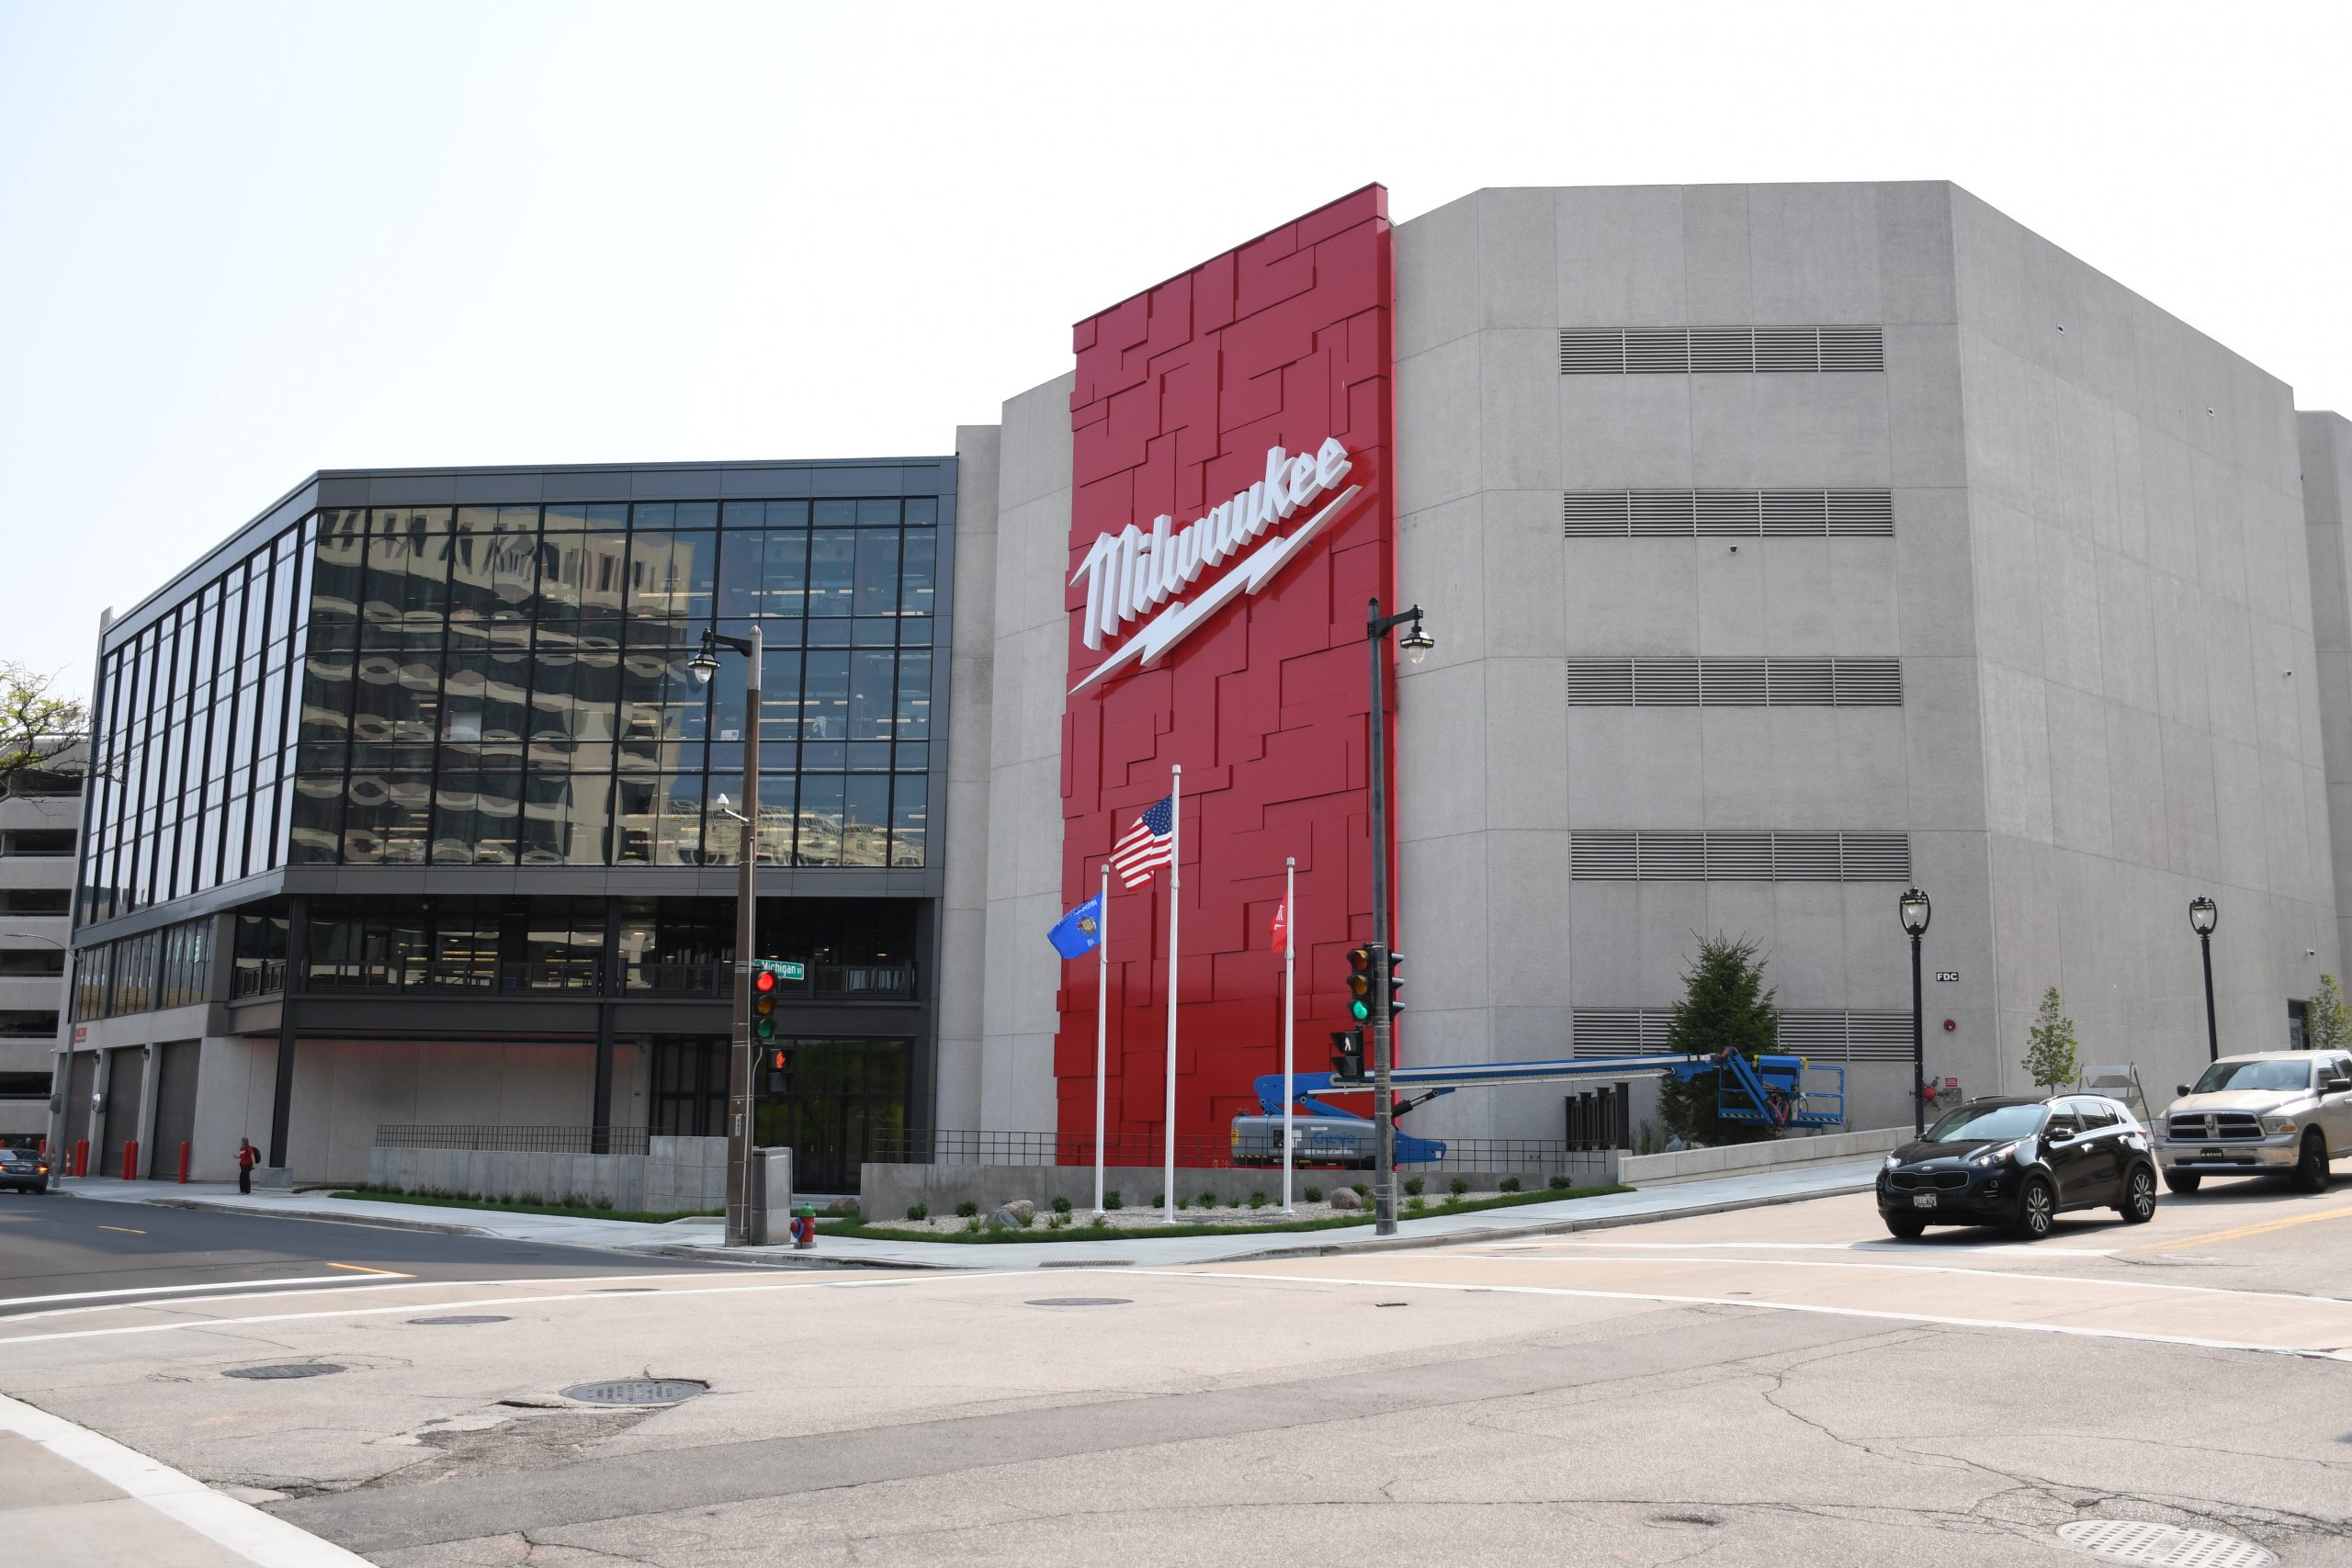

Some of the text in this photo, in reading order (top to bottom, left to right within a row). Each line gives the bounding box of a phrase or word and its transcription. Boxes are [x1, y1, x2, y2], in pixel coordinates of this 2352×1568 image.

[1069, 436, 1352, 650] Milwaukee
[762, 961, 797, 976] Michigan
[1937, 973, 1958, 981] FDC
